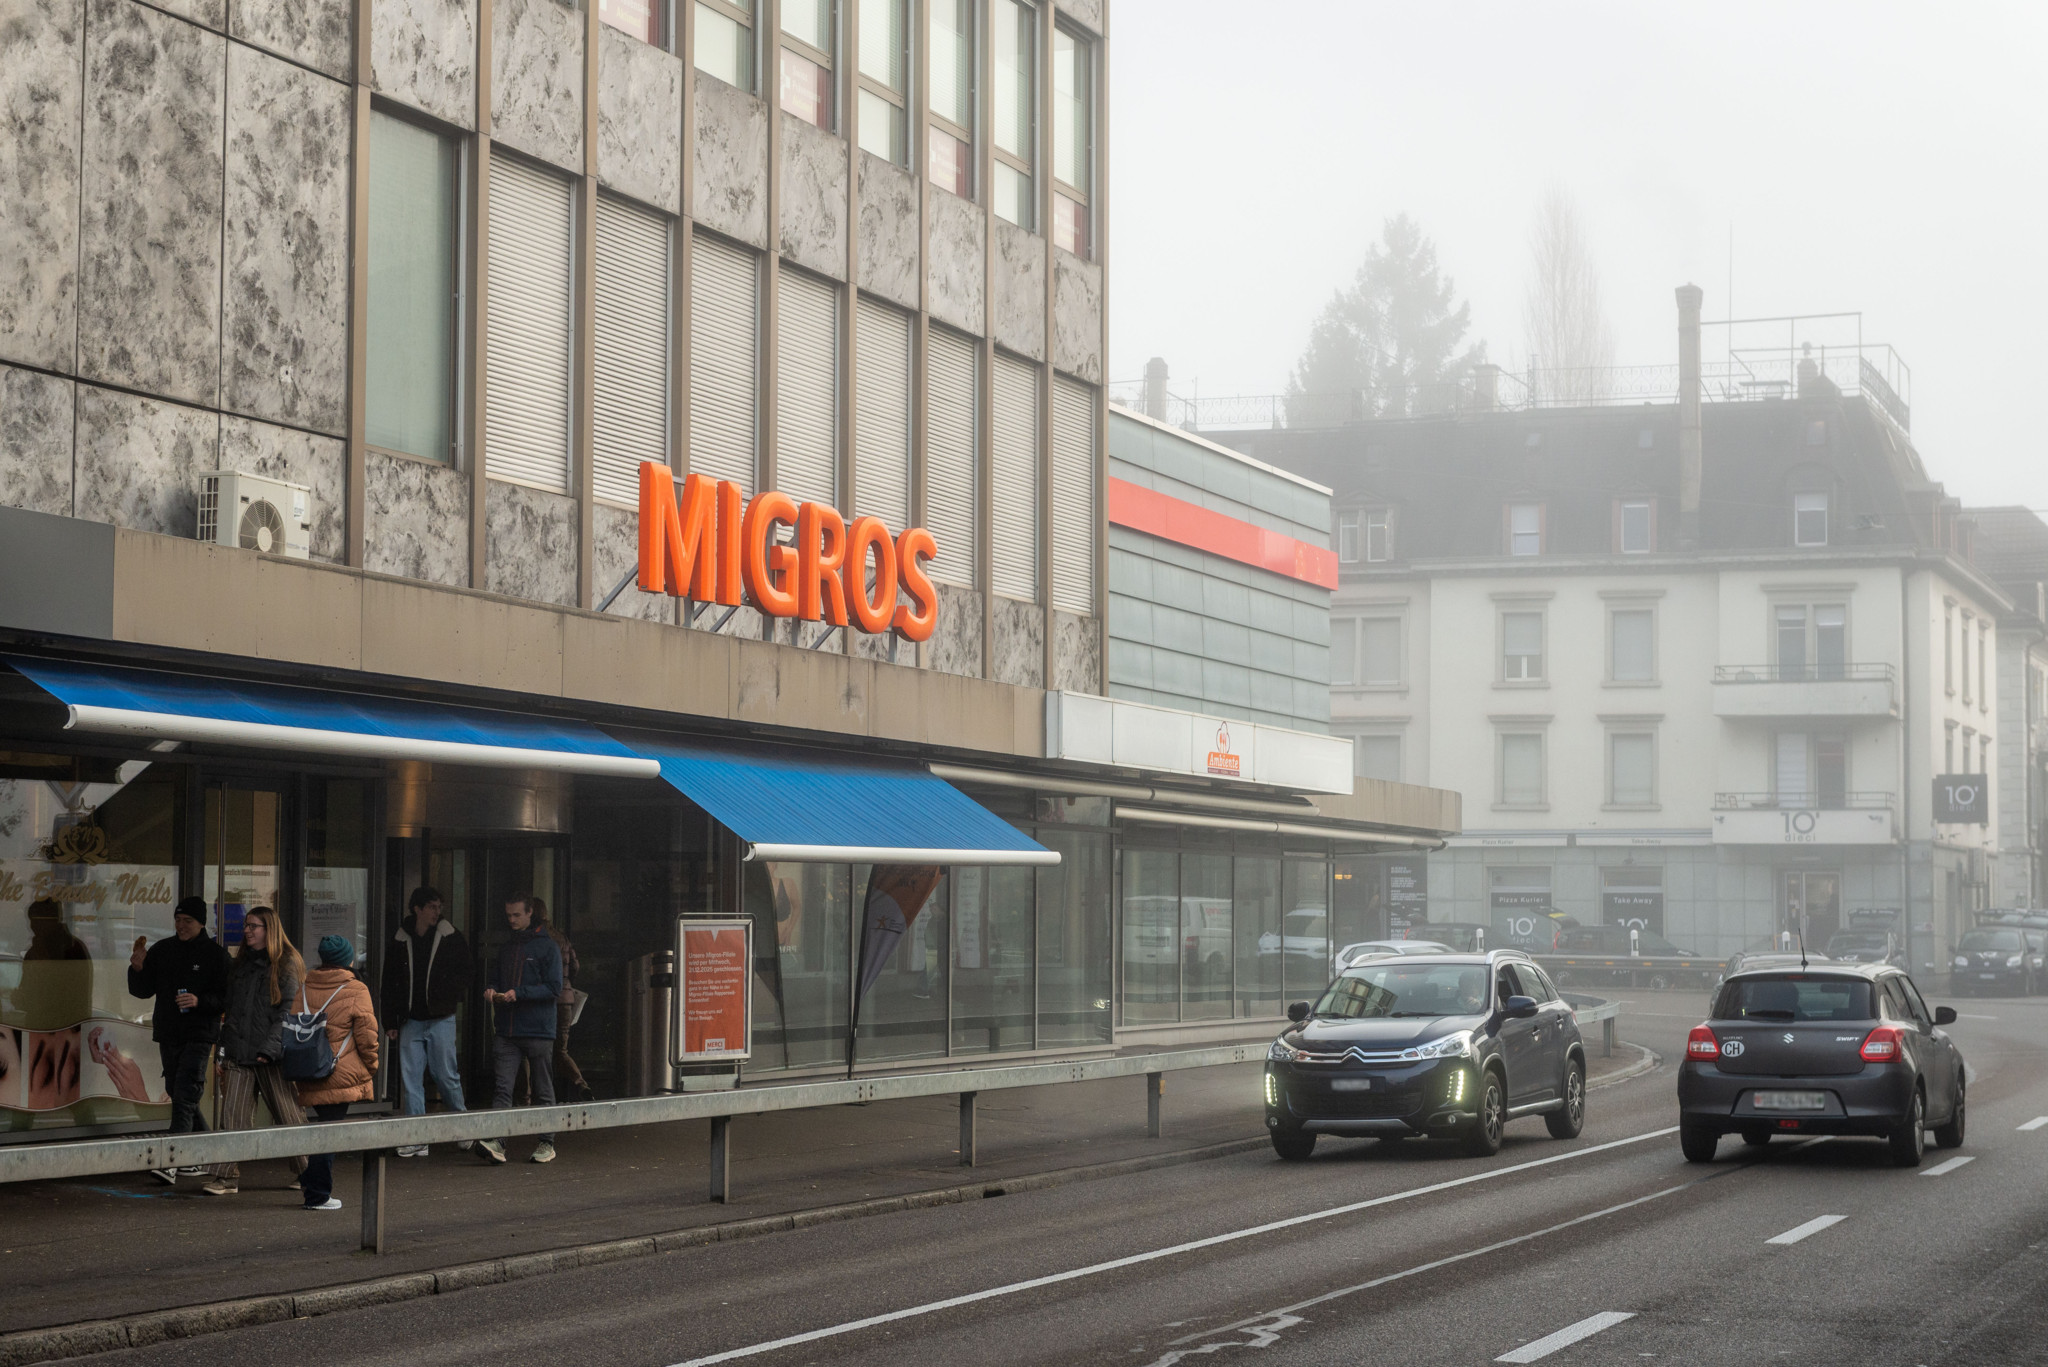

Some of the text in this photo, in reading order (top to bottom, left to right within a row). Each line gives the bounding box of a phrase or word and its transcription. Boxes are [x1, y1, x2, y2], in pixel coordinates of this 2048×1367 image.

[636, 461, 938, 643] MIGROS
[1209, 753, 1239, 769] Ambiente
[1785, 832, 1816, 842] dieci
[0, 871, 173, 910] he Beauty Nails
[1632, 897, 1653, 905] Away
[706, 951, 736, 960] Migros-Filiale
[1725, 1043, 1740, 1056] CH
